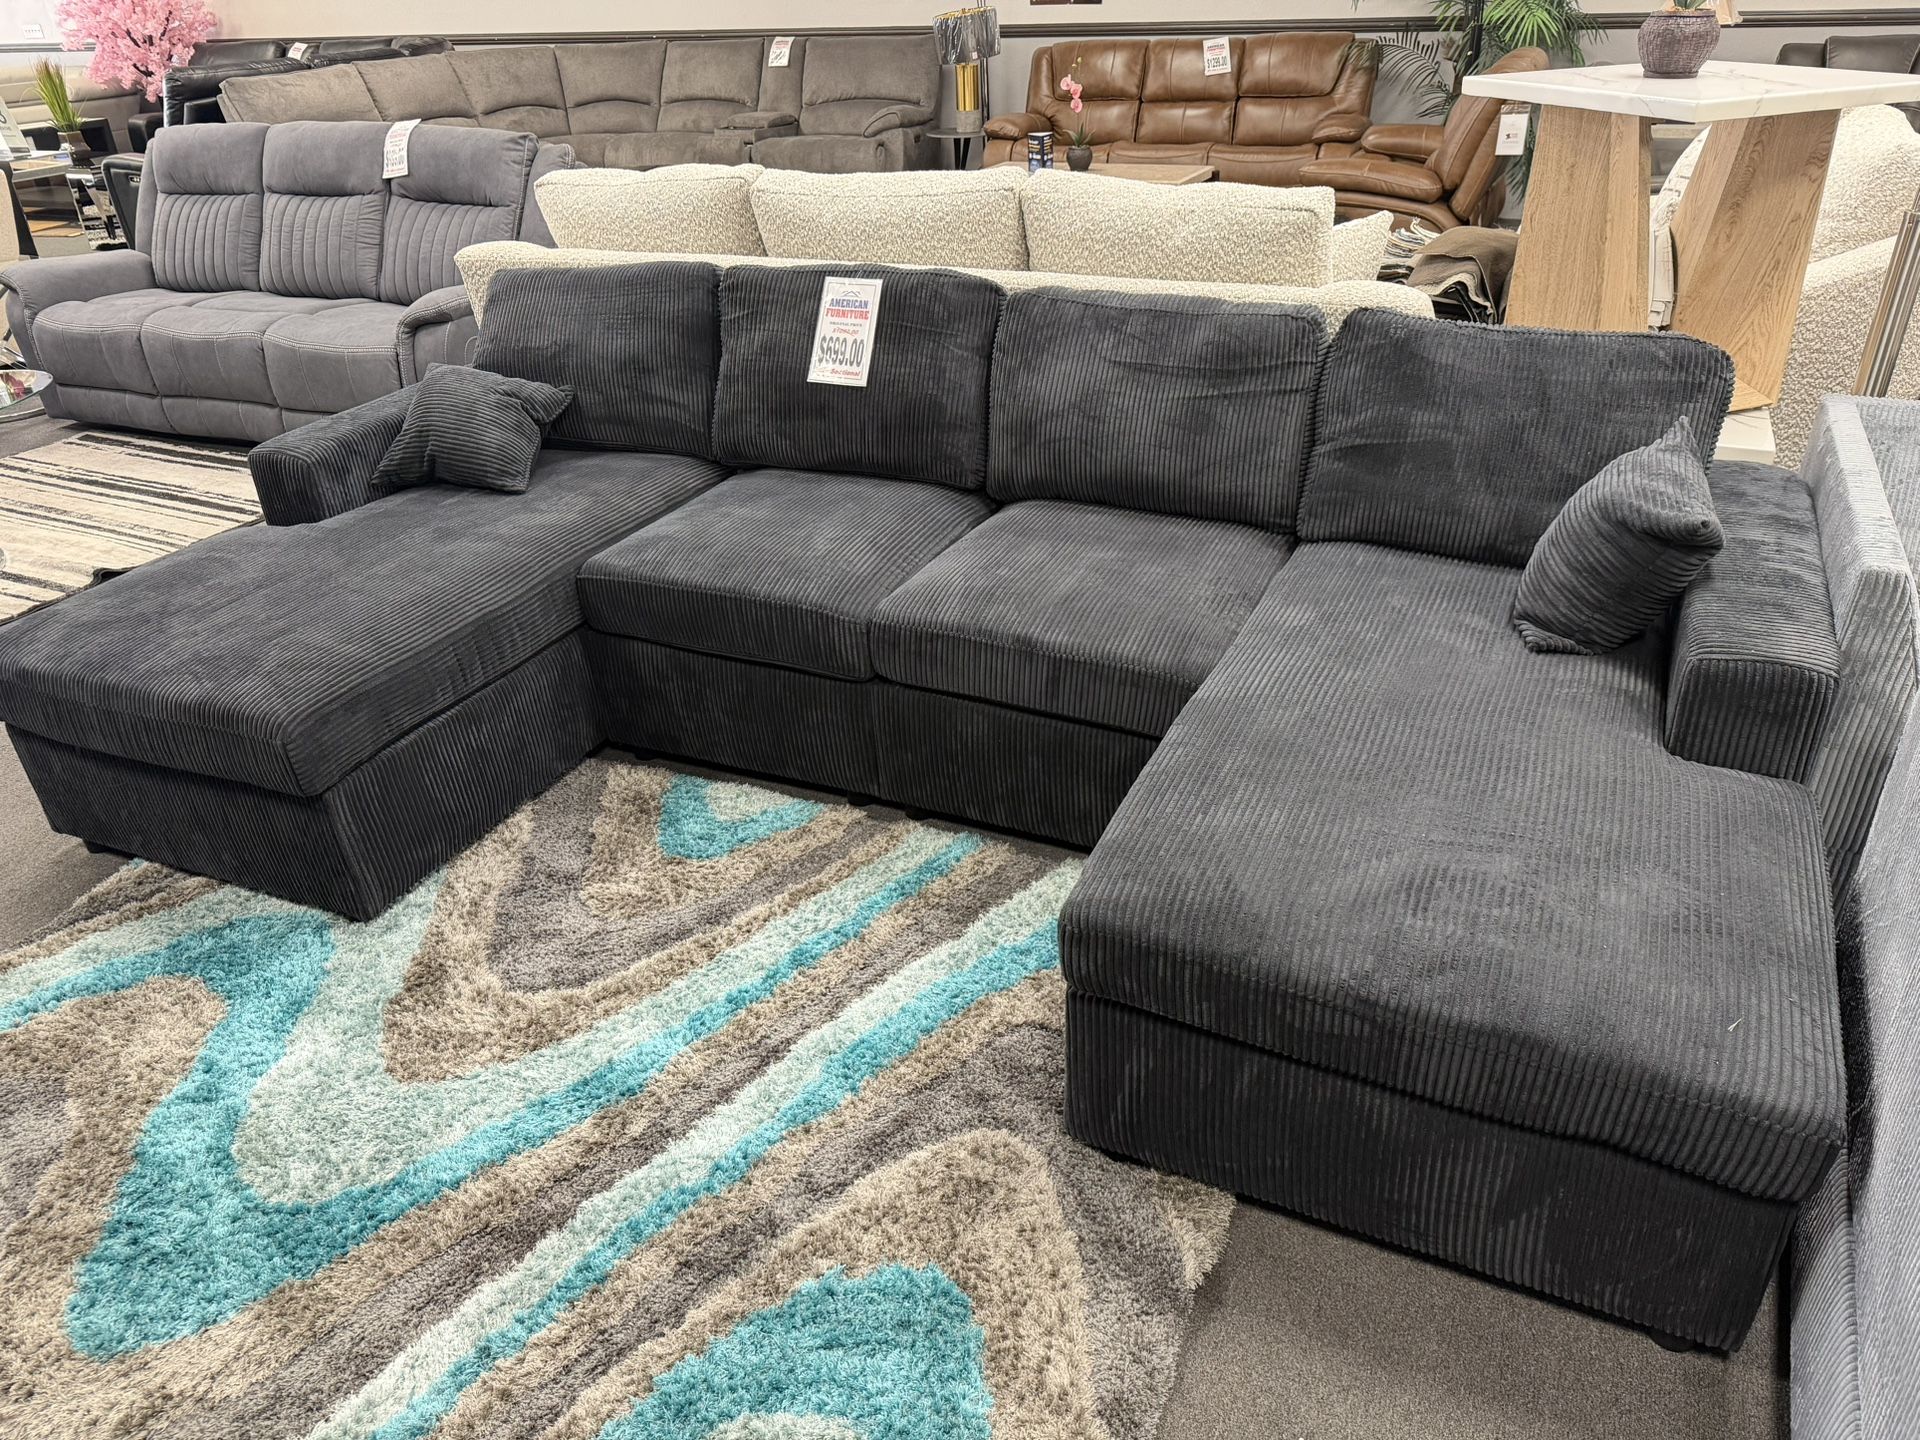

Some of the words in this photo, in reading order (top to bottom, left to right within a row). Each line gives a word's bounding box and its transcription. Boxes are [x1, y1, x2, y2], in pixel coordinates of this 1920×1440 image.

[829, 298, 869, 309] AMERICAN
[825, 308, 870, 320] FURNITURE
[818, 335, 865, 368] $699.00
[831, 368, 861, 377] Sectional
